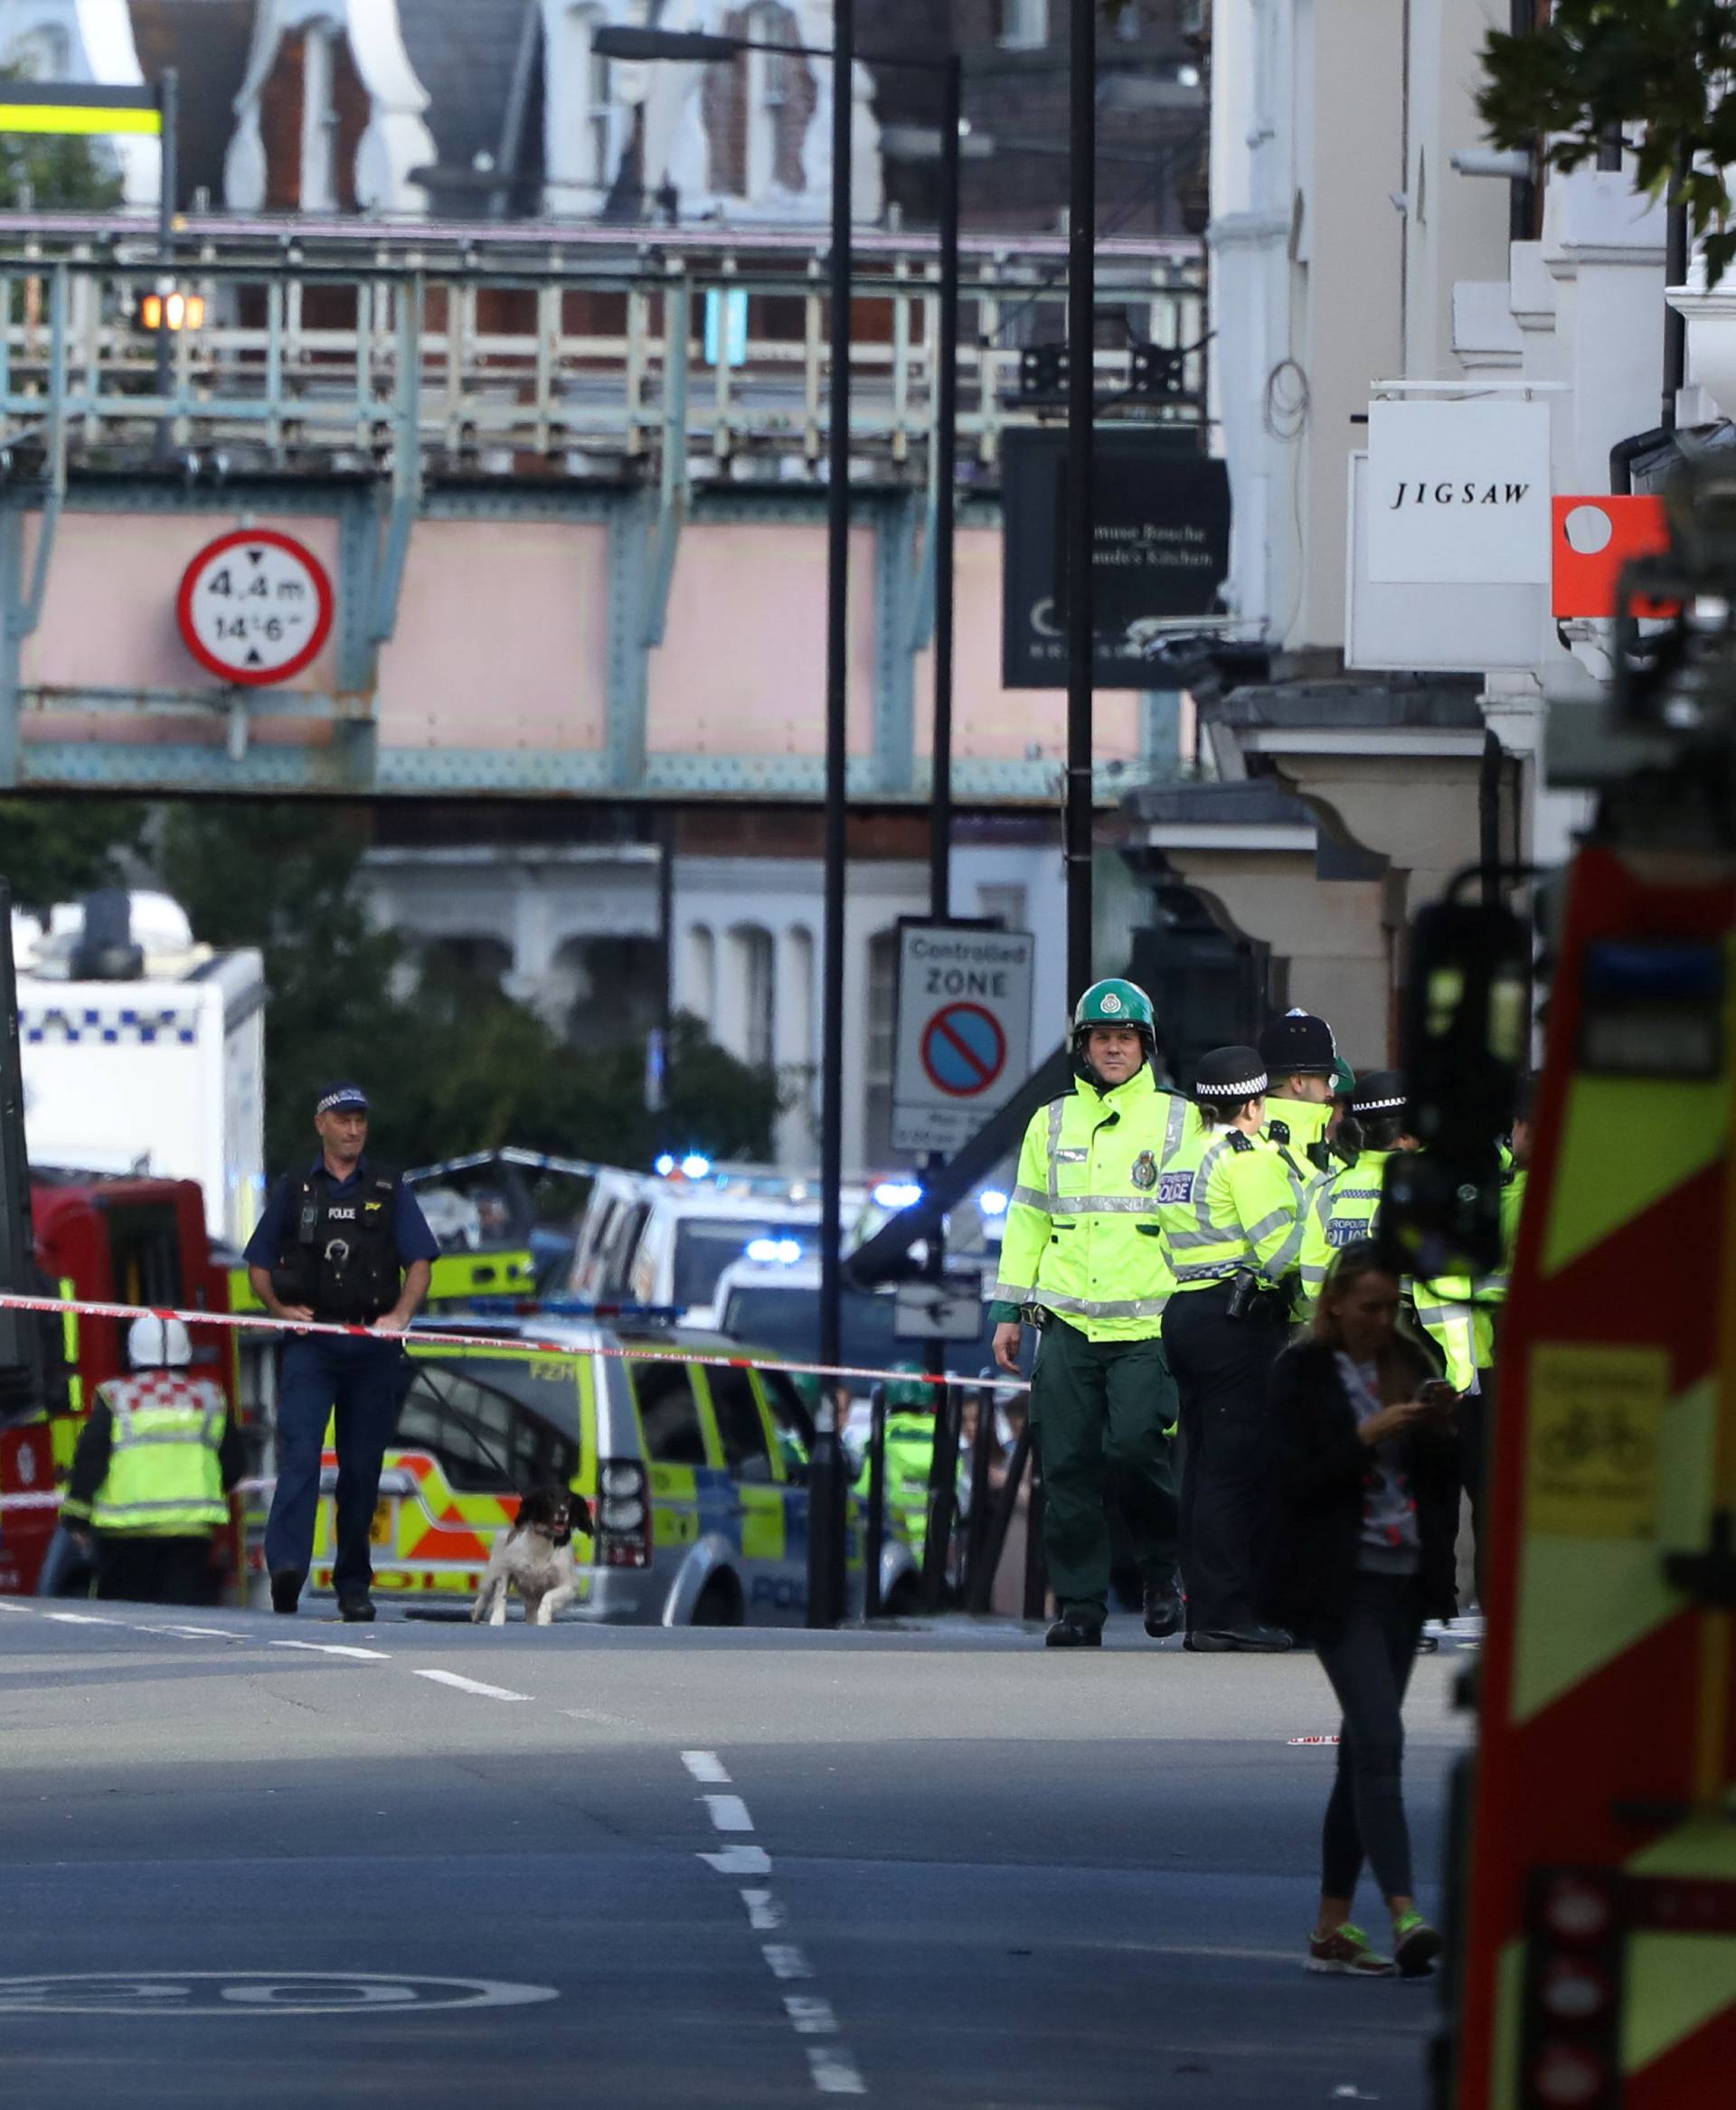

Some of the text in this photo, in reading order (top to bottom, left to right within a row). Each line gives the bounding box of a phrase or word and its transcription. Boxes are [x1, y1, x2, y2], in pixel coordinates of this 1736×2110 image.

[1390, 483, 1530, 510] JIGSAW
[911, 938, 1026, 964] Controlled
[926, 967, 1008, 998] ZONE
[1158, 1183, 1190, 1201] OLICE
[327, 1207, 356, 1220] POLICE
